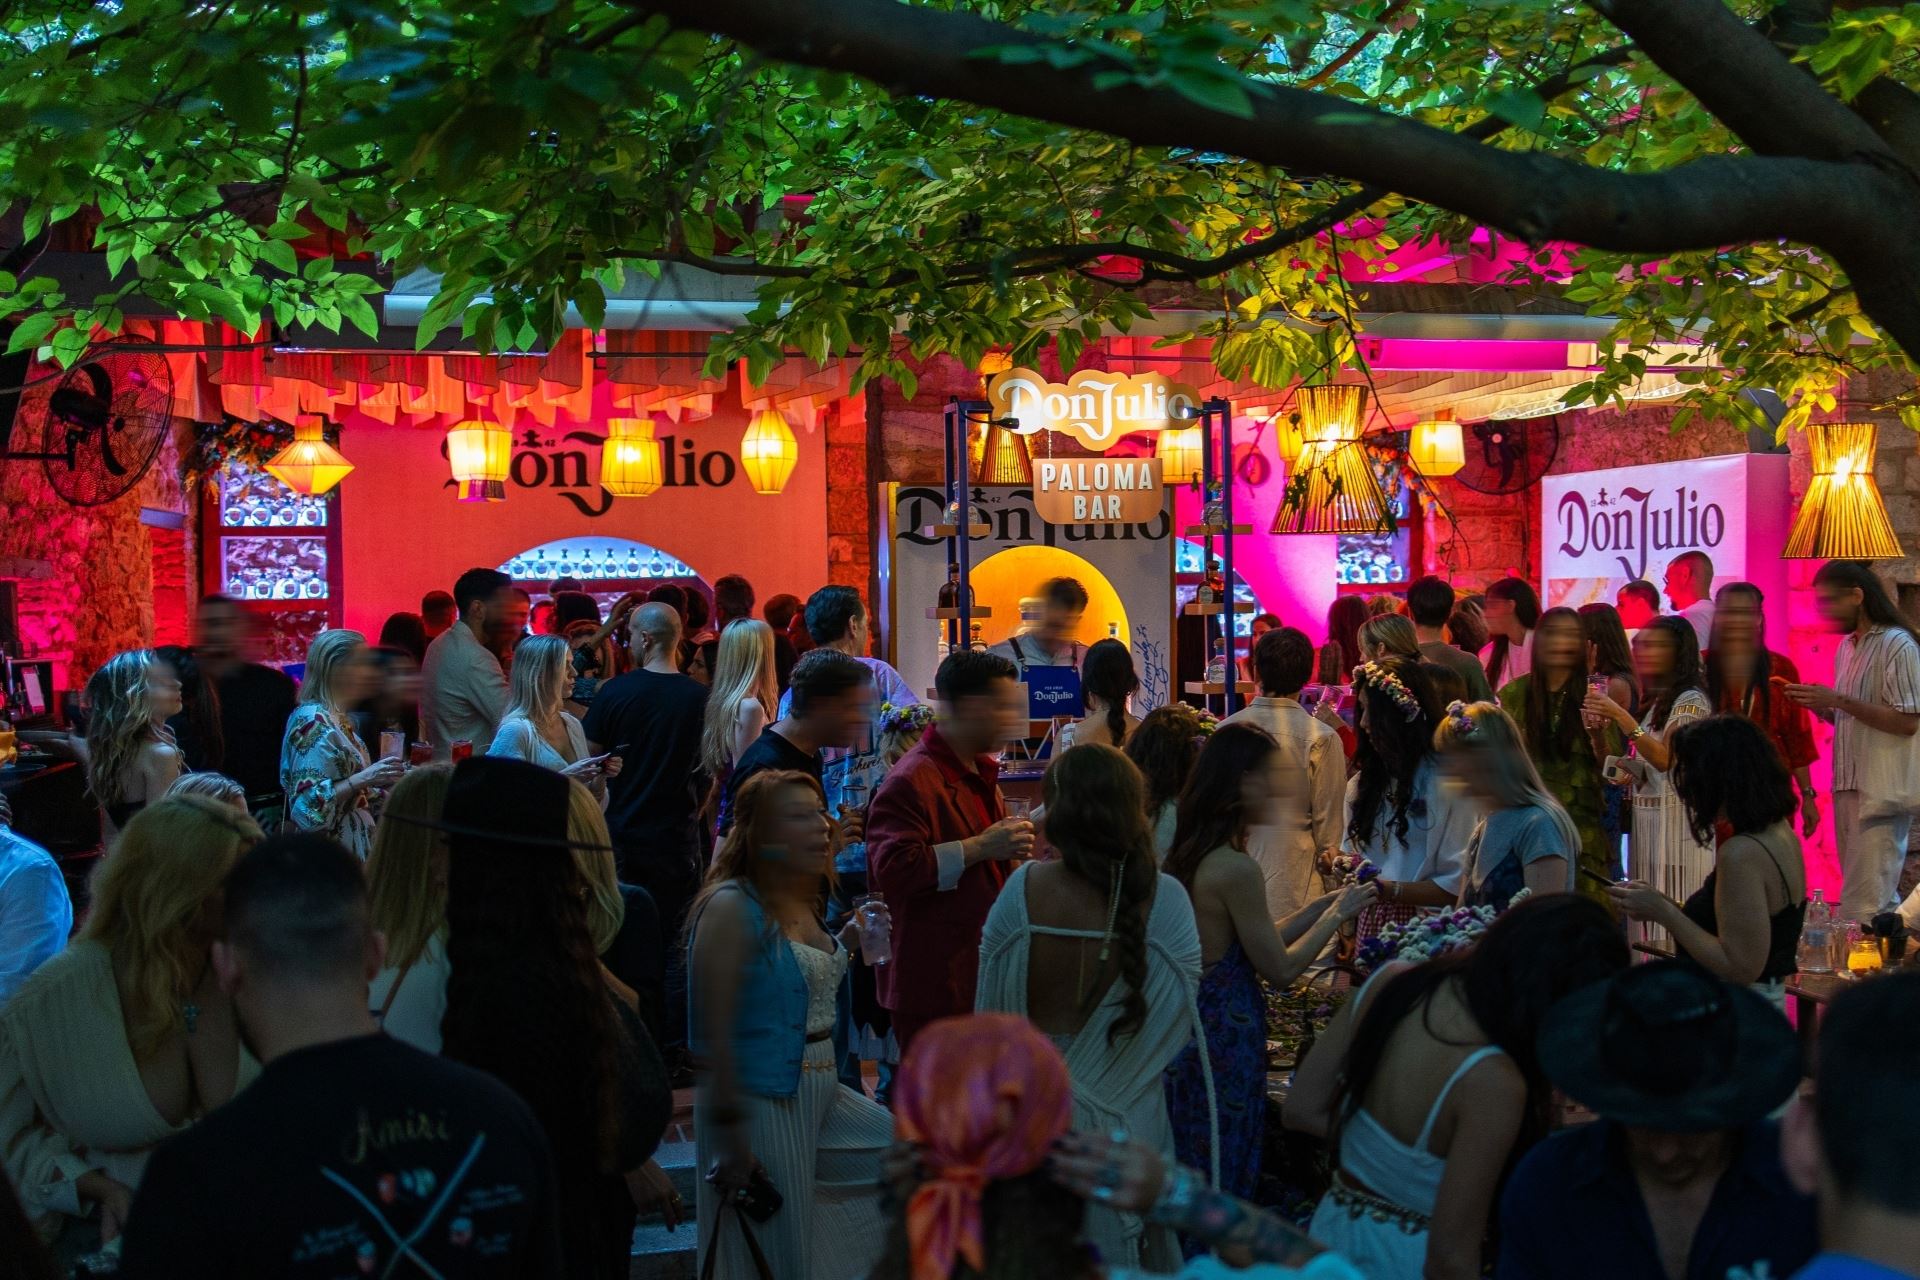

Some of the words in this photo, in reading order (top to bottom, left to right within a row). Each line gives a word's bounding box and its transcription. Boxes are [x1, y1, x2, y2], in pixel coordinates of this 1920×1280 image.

[998, 378, 1097, 424] Don
[1070, 379, 1193, 441] Julio
[1041, 463, 1153, 492] PALOMA
[990, 496, 1001, 504] 42
[1073, 495, 1122, 521] BAR
[1557, 490, 1636, 558] Don
[1616, 486, 1725, 581] Julio
[1033, 690, 1055, 701] Don
[1050, 691, 1073, 704] Julio
